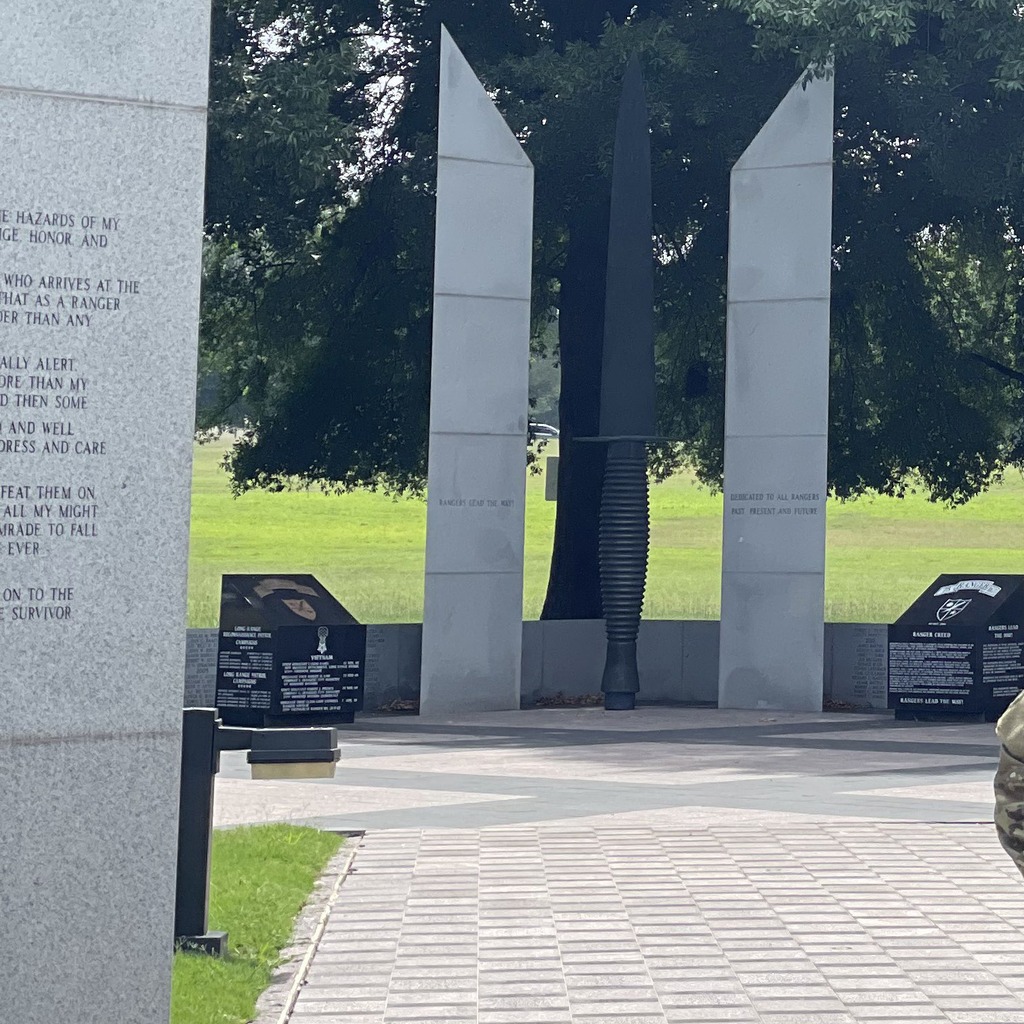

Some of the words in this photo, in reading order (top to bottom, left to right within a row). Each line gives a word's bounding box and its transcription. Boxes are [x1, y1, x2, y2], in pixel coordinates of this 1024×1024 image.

[0, 210, 9, 223] E
[16, 211, 75, 227] HAZARDS
[82, 216, 96, 228] OF
[102, 217, 120, 230] MY
[82, 235, 108, 247] AND
[4, 273, 32, 288] WHO
[39, 276, 90, 291] ARRIVES
[97, 279, 111, 292] AT
[118, 279, 139, 294] THE
[35, 294, 49, 307] AS
[57, 295, 64, 308] A
[72, 296, 120, 310] RANGER
[25, 312, 59, 325] THAN
[66, 315, 93, 327] ANY
[0, 357, 30, 369] ALLY
[29, 376, 62, 389] THAN
[70, 378, 88, 391] MY
[15, 394, 48, 408] THEN
[55, 396, 88, 409] SOME
[9, 421, 35, 434] AND
[43, 422, 74, 435] WELL
[42, 441, 68, 454] AND
[75, 441, 106, 455] CARE
[1, 485, 30, 499] FEAT
[37, 486, 71, 499] THEM
[78, 486, 95, 499] ON
[4, 505, 26, 517] ALL
[34, 505, 52, 517] MY
[59, 505, 98, 518] MIGHT
[48, 523, 64, 536] TO
[71, 523, 98, 536] FALL
[8, 542, 39, 555] EVER
[3, 588, 21, 601] ON
[28, 588, 43, 601] TO
[50, 588, 73, 600] THE
[12, 606, 71, 620] SURVIVOR
